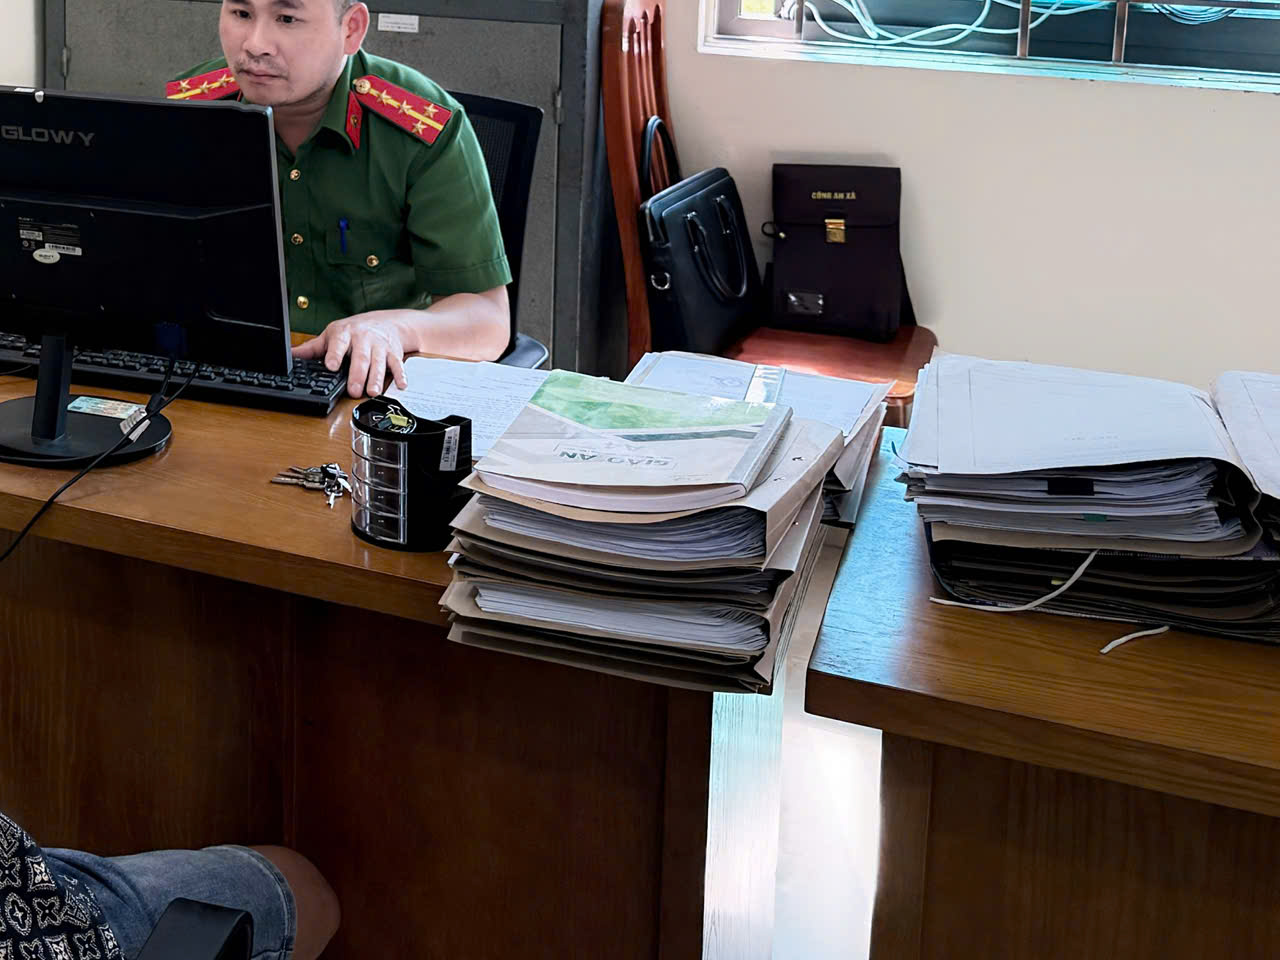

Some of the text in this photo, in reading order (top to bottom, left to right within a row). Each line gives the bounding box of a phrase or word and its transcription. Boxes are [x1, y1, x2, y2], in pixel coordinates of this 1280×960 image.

[1, 125, 95, 147] GLOWY
[811, 191, 832, 200] CÔNG
[833, 192, 845, 200] AN
